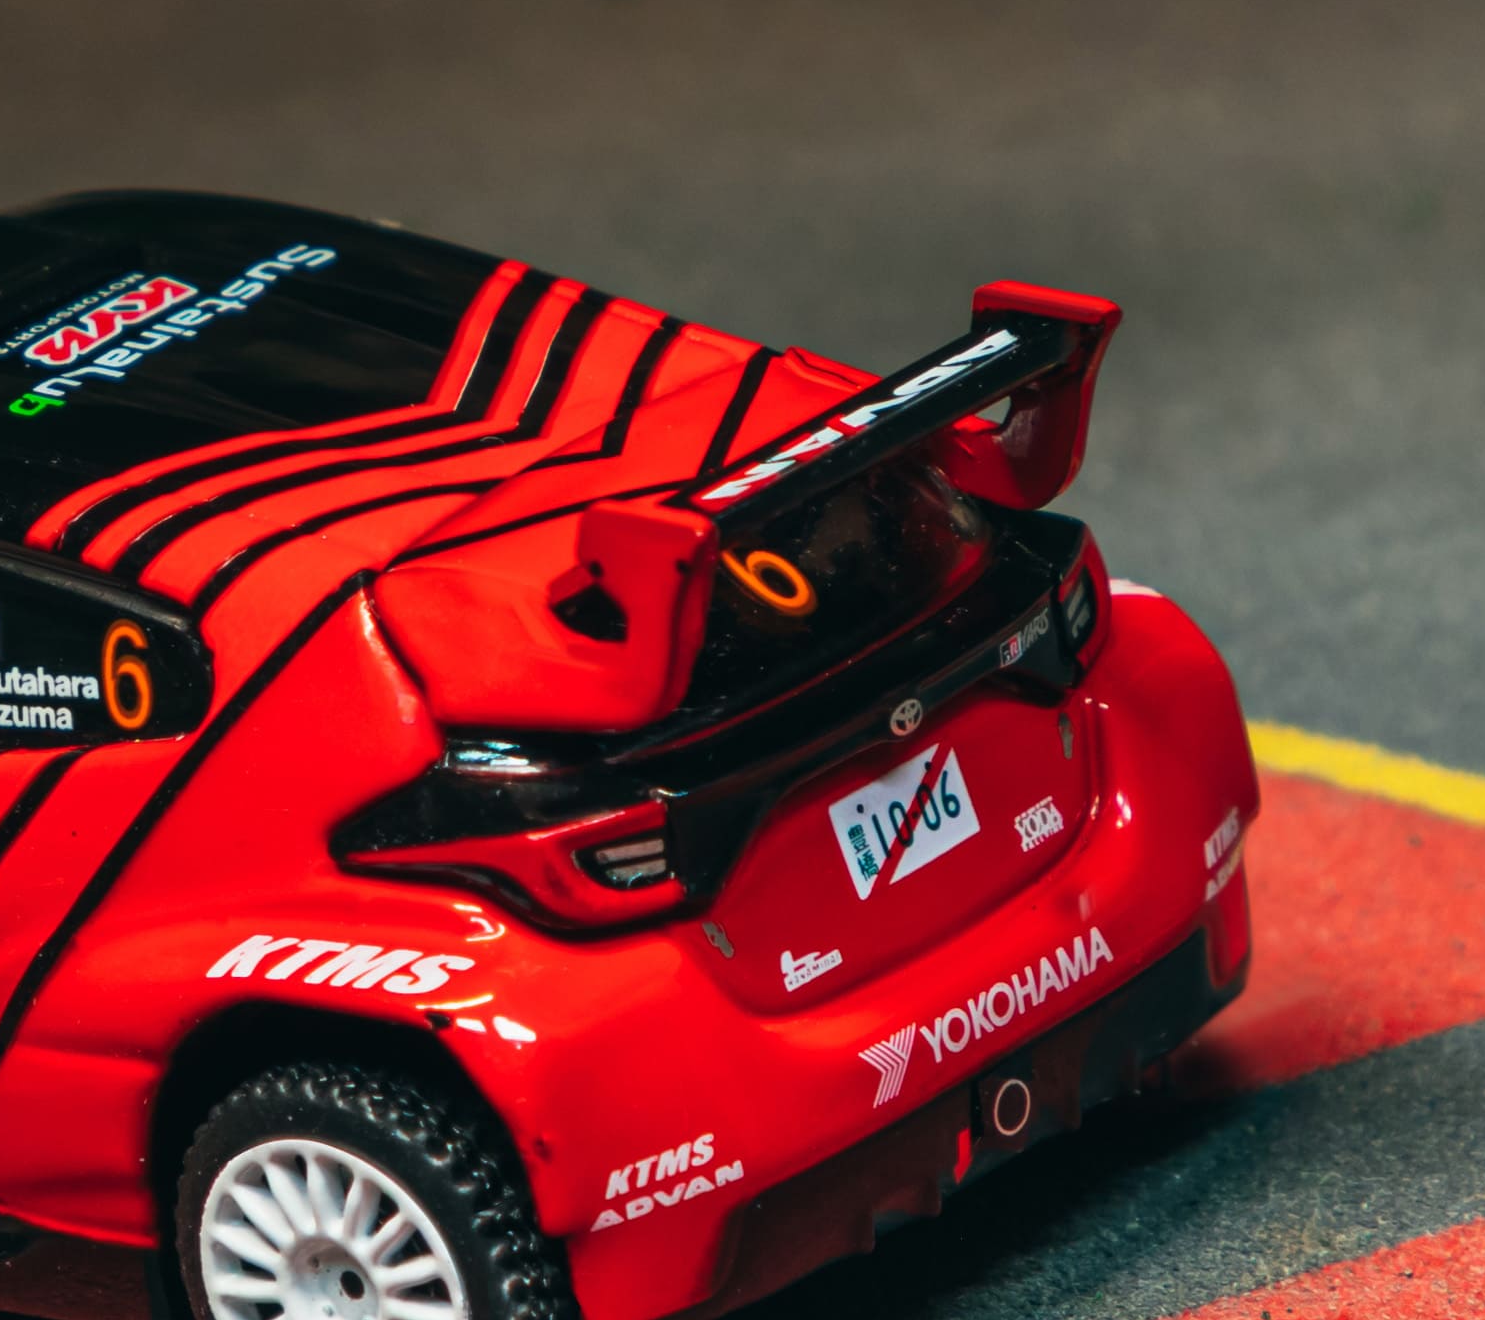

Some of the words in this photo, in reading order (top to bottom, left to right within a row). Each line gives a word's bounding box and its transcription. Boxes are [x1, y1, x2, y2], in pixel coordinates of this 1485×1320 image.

[24, 276, 198, 366] KYB
[101, 619, 151, 729] 6
[205, 936, 475, 995] KTMS
[919, 926, 1114, 1064] YOKOHAMA
[590, 1160, 745, 1233] ADVAN
[604, 1133, 714, 1200] KTMS
